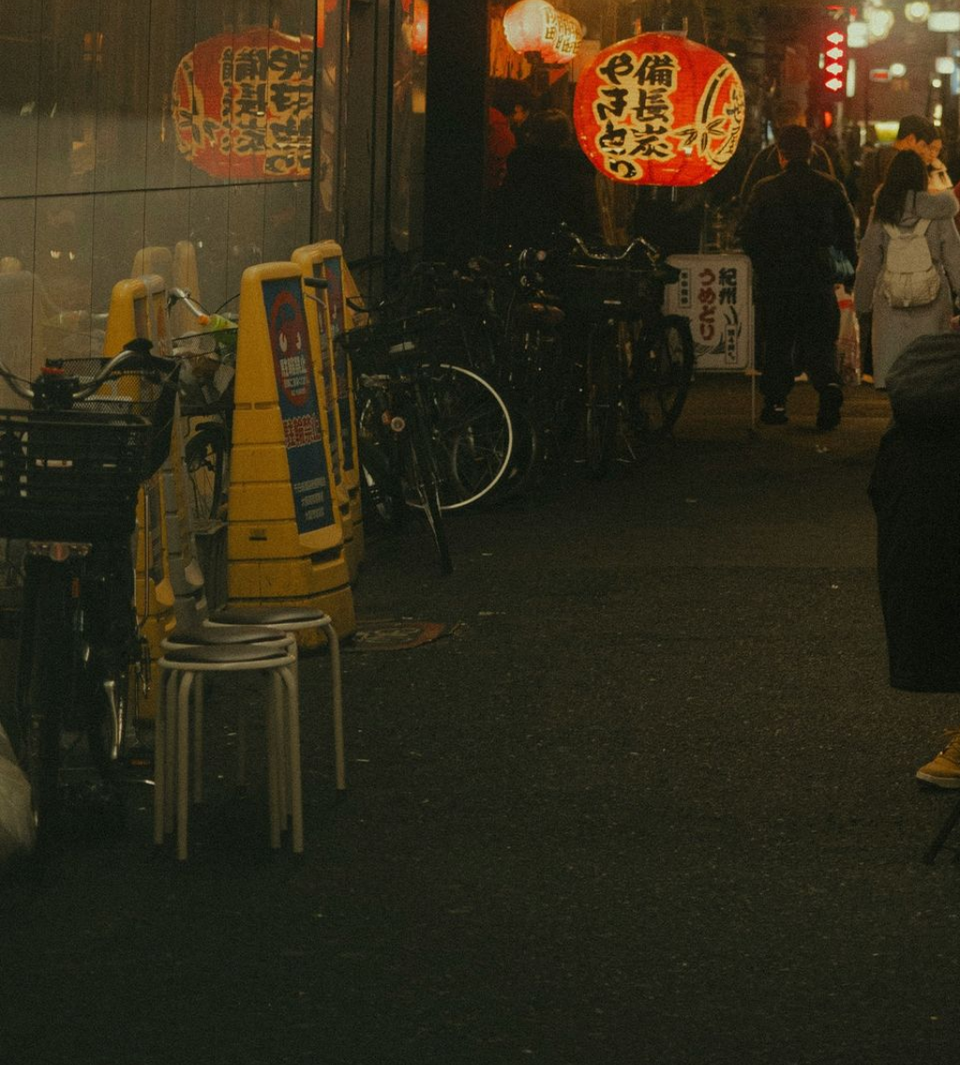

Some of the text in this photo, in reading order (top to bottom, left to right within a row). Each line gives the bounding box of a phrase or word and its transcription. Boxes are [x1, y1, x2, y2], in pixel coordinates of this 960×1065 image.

[596, 52, 638, 179] やきとり
[629, 54, 677, 158] 備長炭
[697, 267, 717, 341] うめどり
[718, 267, 738, 305] 紀州
